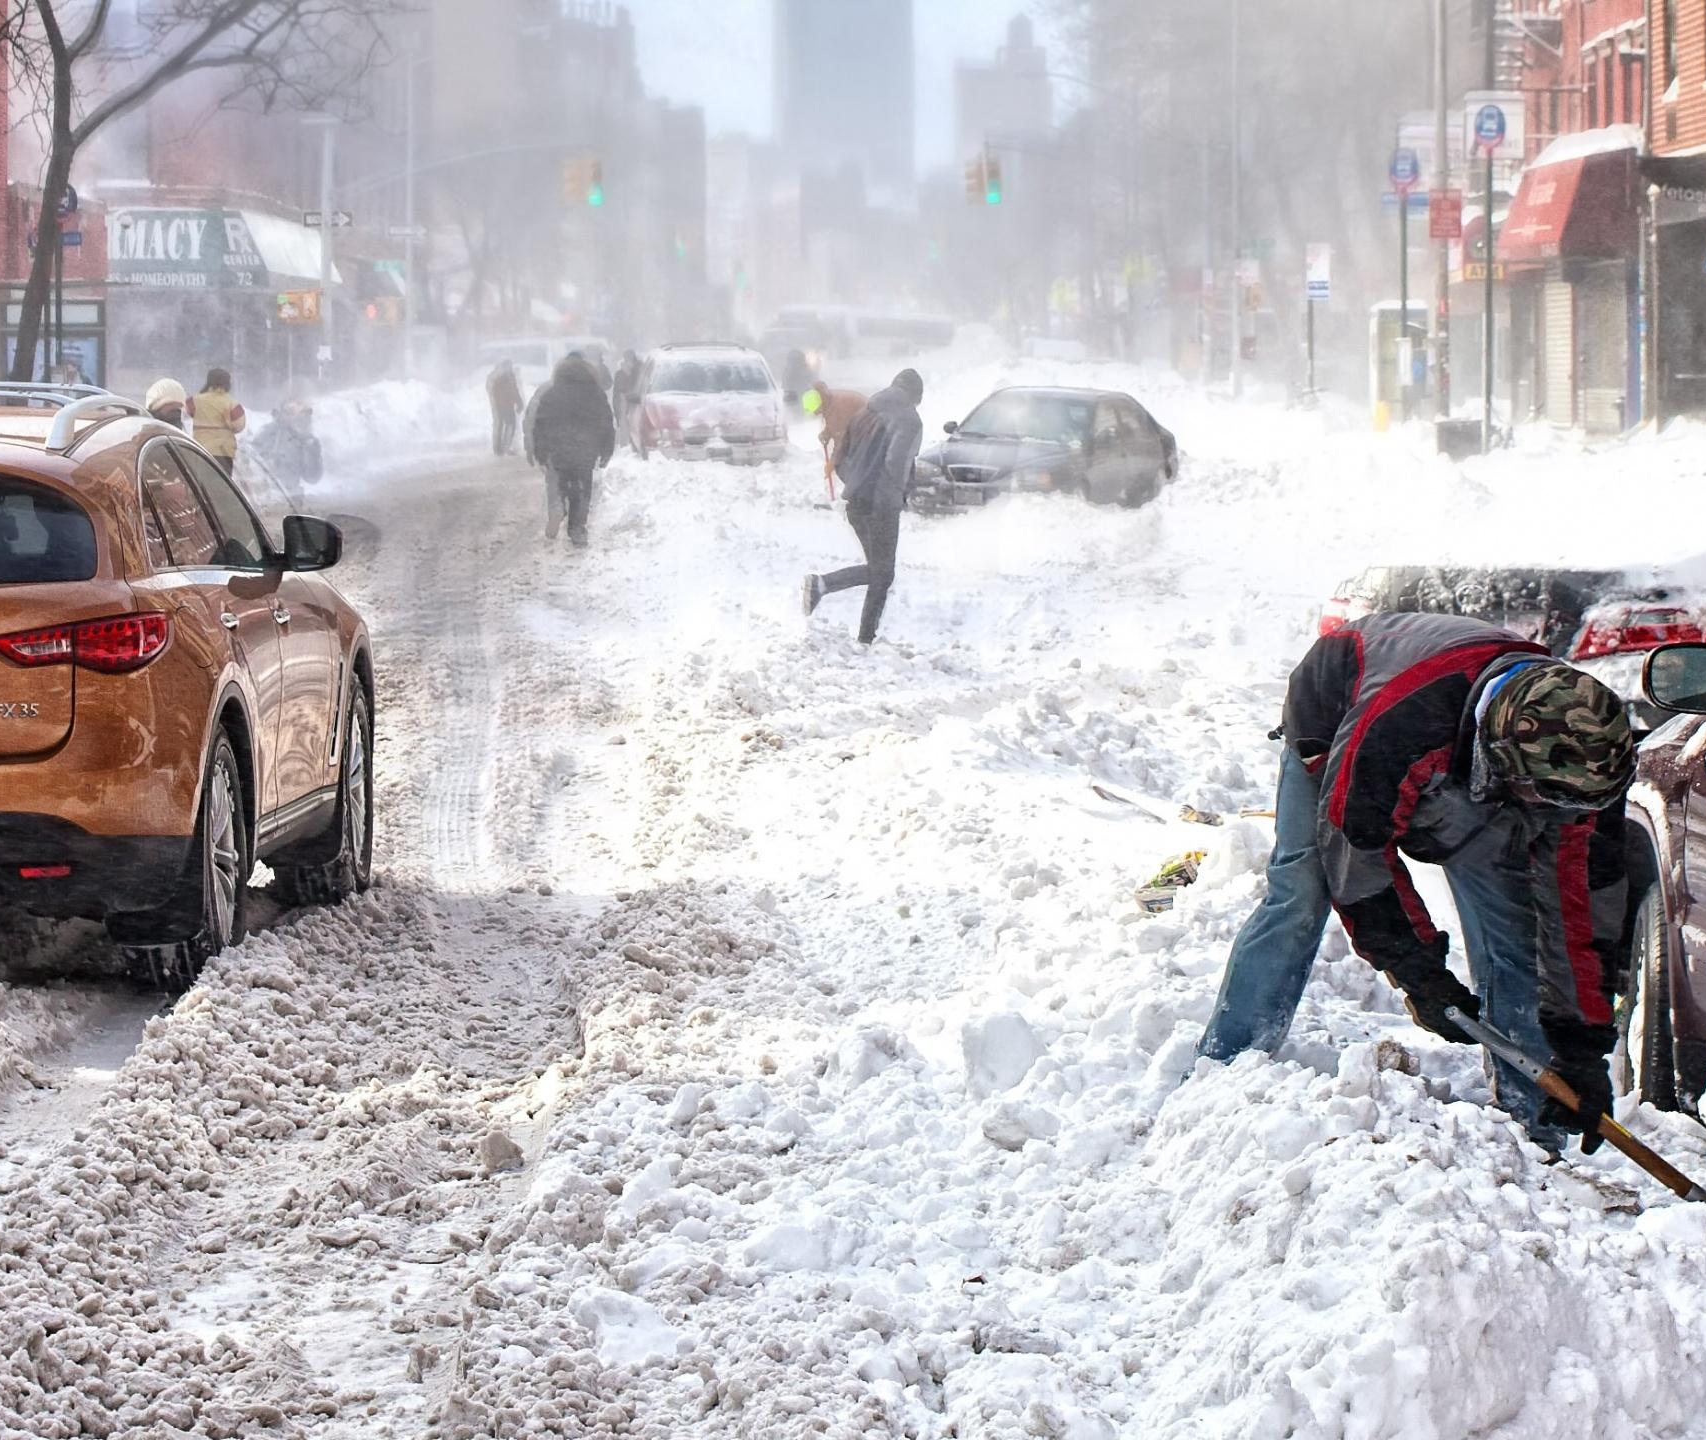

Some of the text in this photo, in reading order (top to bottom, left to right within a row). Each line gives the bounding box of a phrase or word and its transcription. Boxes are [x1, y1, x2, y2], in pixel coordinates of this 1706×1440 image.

[223, 254, 261, 266] CENTER
[131, 271, 208, 287] HOMEOPATHY
[237, 272, 253, 286] 72
